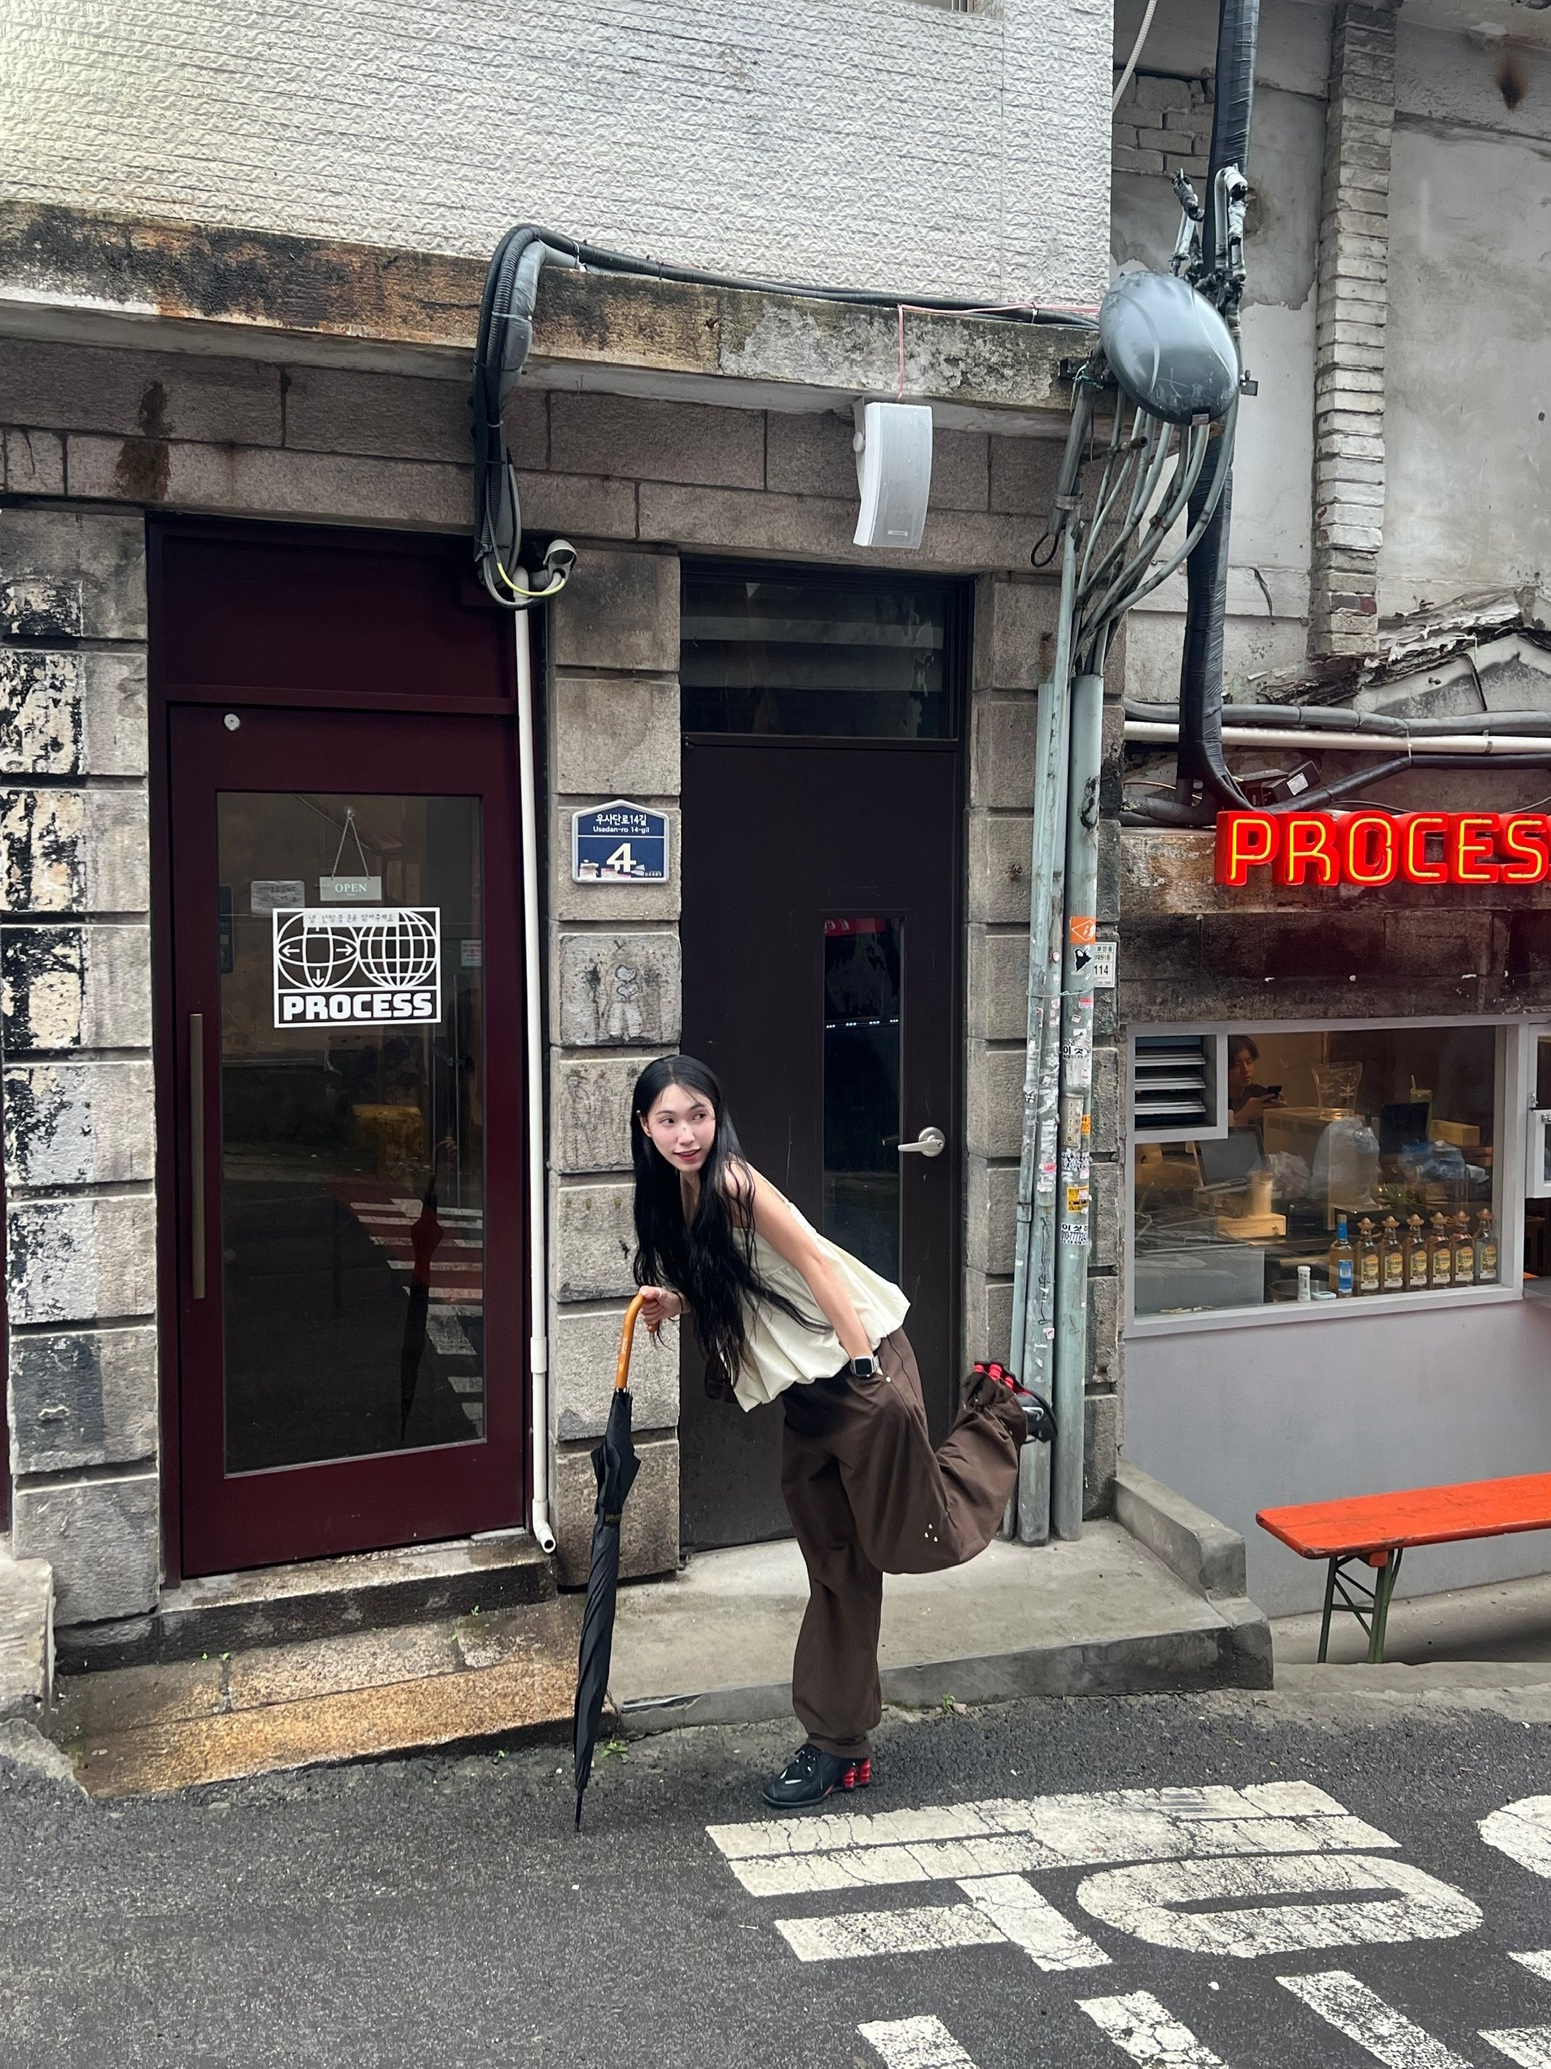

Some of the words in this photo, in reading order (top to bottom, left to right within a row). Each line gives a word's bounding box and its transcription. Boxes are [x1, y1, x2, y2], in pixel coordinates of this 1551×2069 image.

[595, 813, 647, 826] 우사단로14길
[631, 826, 649, 834] 14-gil
[1215, 810, 1551, 887] PROCES
[606, 842, 637, 873] 4
[334, 882, 367, 893] OPEN
[1093, 964, 1109, 975] 114
[282, 992, 433, 1021] PROCESS
